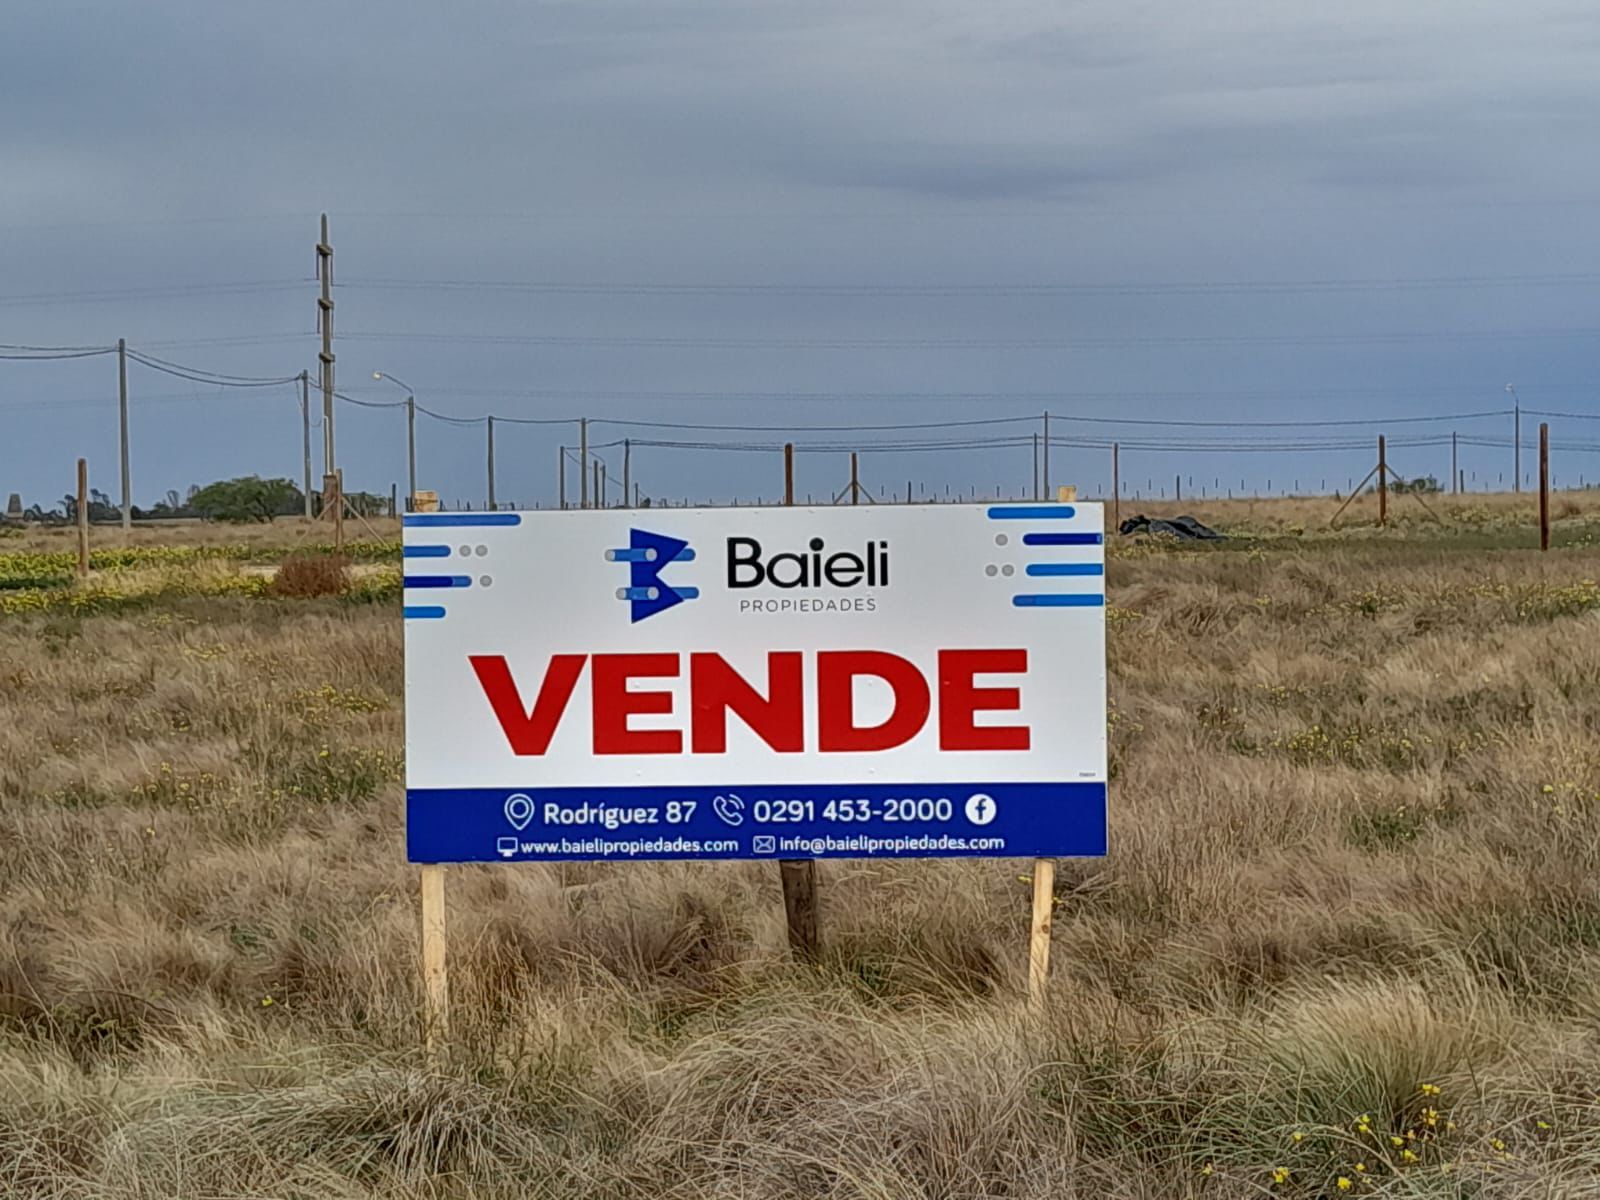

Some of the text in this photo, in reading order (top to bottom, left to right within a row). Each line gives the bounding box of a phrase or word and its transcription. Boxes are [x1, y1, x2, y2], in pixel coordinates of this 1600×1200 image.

[727, 537, 888, 588] Baieli
[740, 598, 877, 612] PROPIEDADES
[469, 649, 1031, 757] VENDE
[545, 801, 697, 828] Rodríguez 87
[753, 799, 953, 823] 0291 453-2000
[520, 837, 739, 856] www.baielipropiedades.com
[780, 834, 1005, 854] info@baielipropiedades.com
